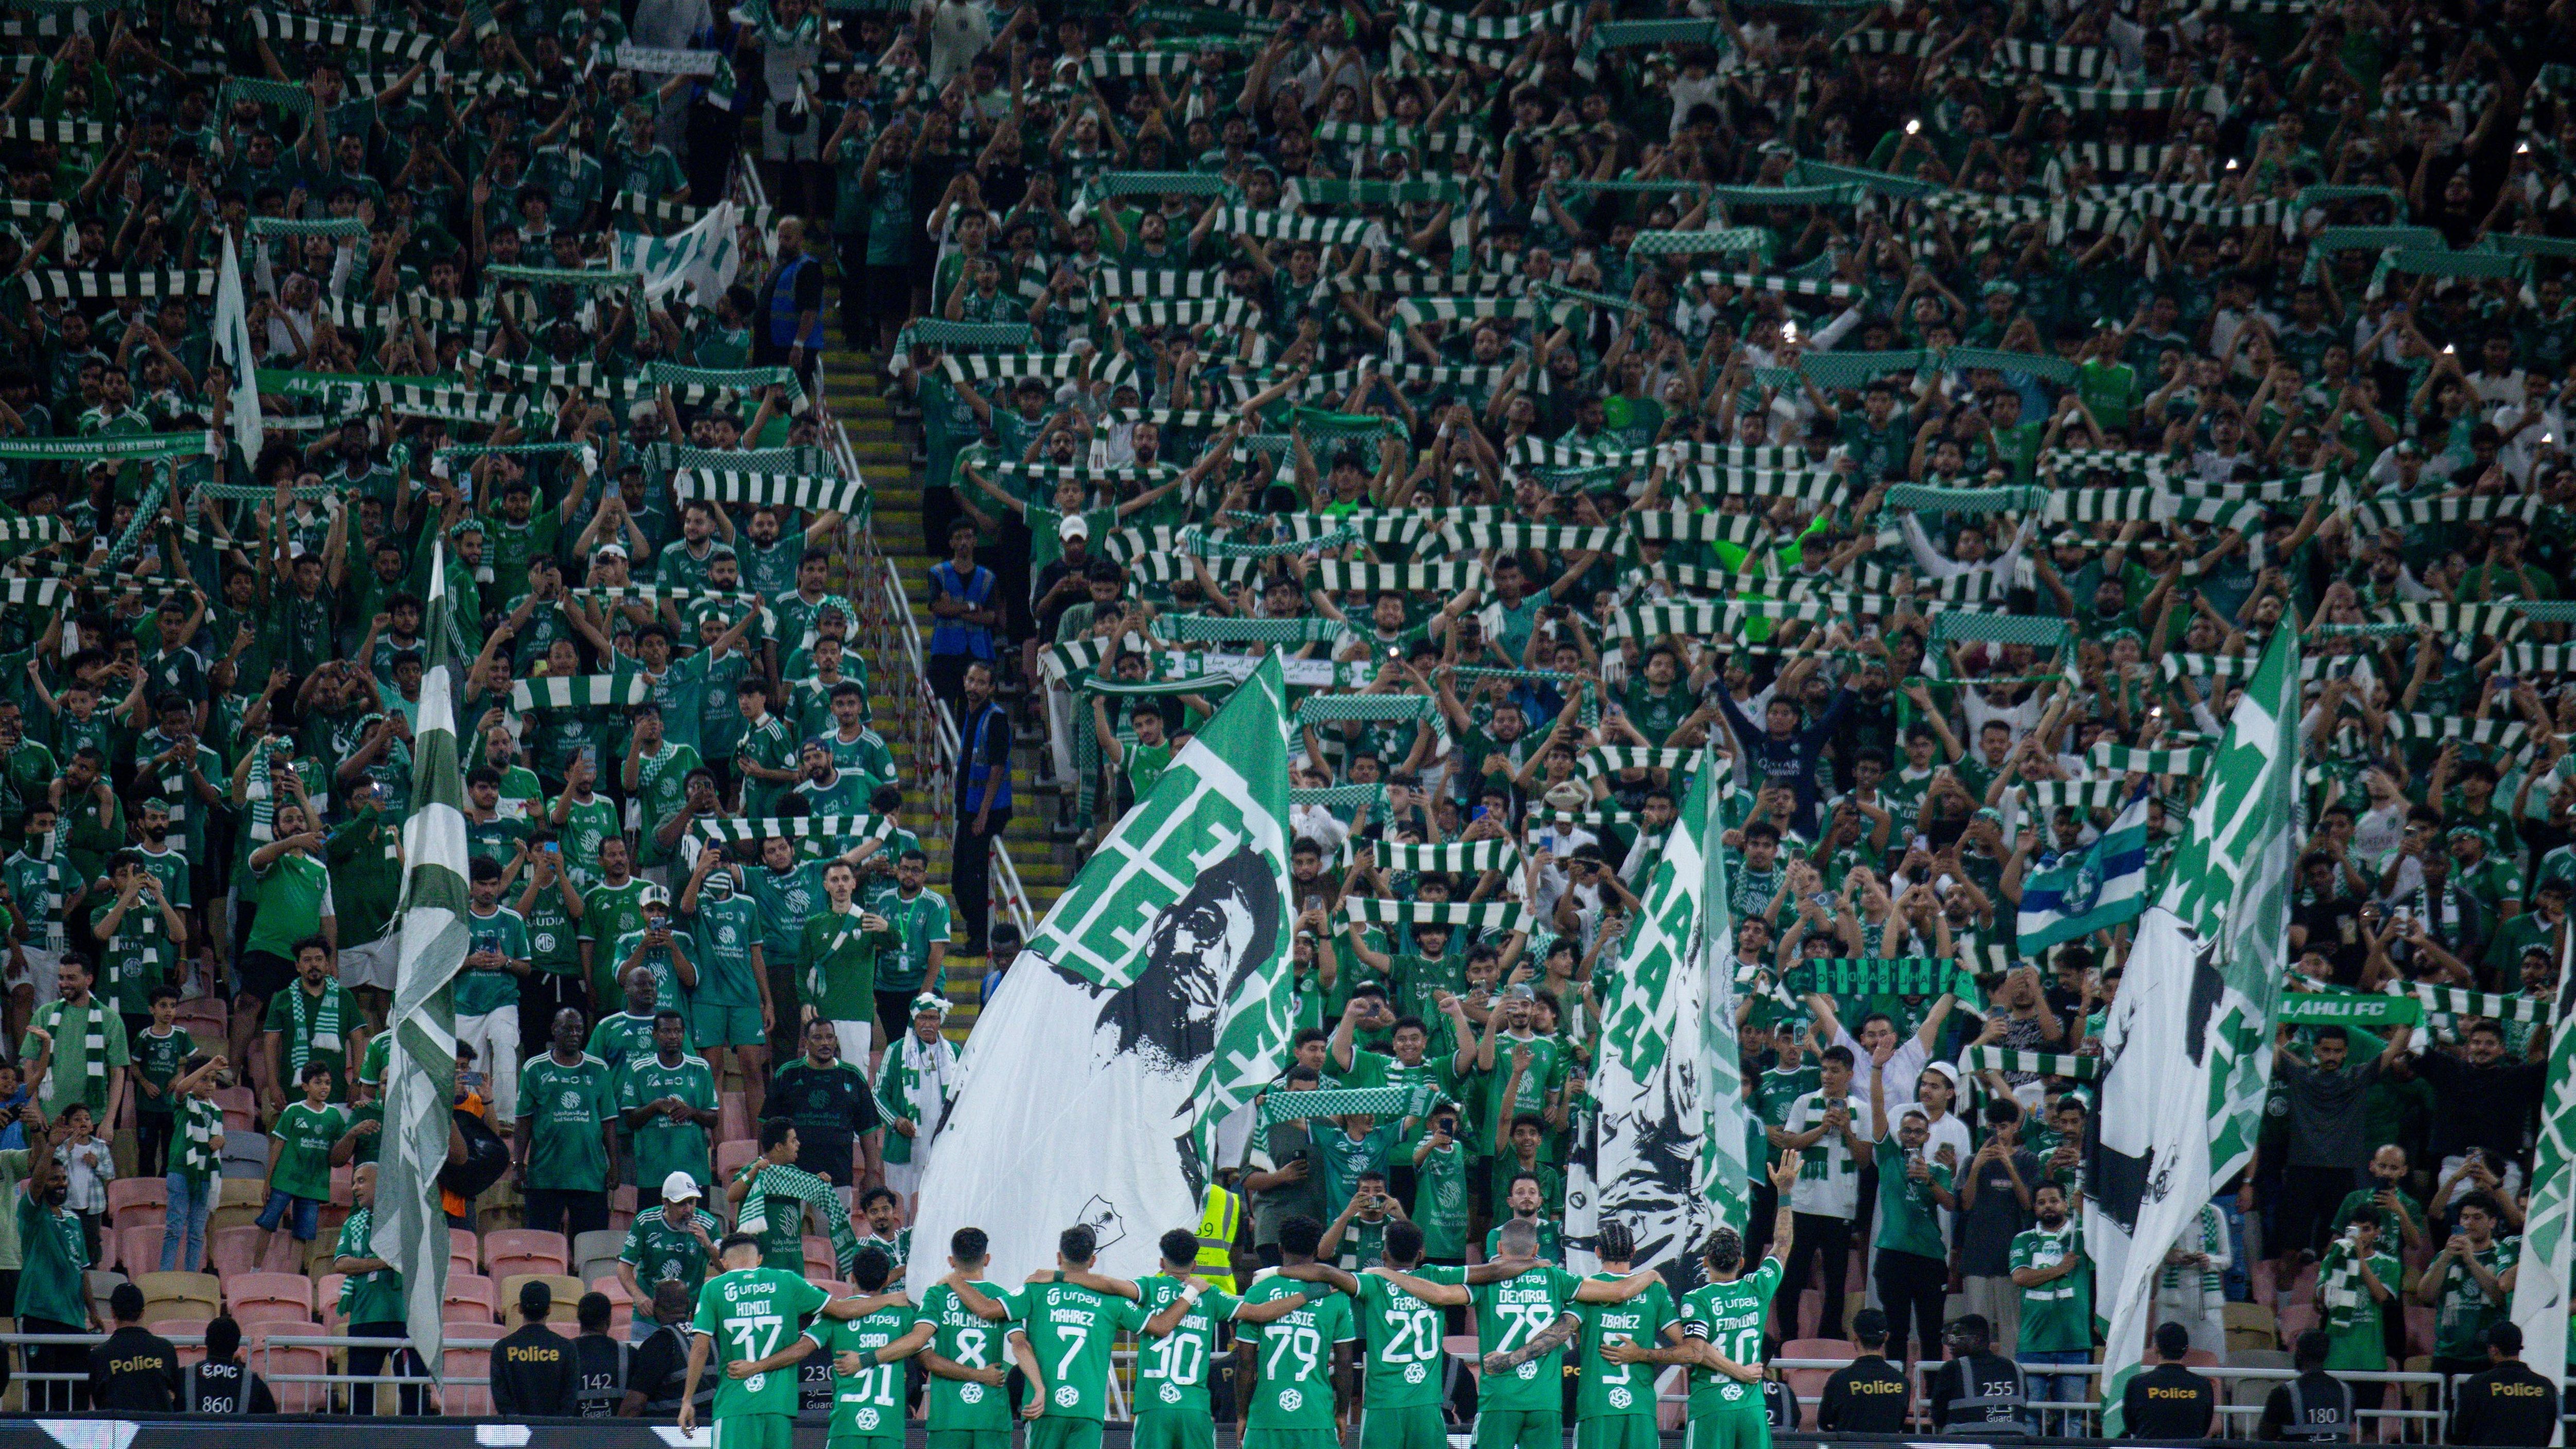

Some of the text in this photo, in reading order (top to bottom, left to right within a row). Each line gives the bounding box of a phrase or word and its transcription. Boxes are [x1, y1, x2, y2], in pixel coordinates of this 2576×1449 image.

[45, 443, 103, 453] ALWAYS
[1758, 758, 1799, 769] QATAR
[526, 916, 565, 928] SAUDIA
[2353, 1002, 2387, 1017] FC
[739, 1280, 776, 1295] urpay
[1063, 1291, 1102, 1307] urpay
[1499, 1289, 1551, 1303] DEMIRAL
[1725, 1295, 1759, 1310] urpay
[736, 1300, 771, 1317] HINDI
[863, 1313, 900, 1326] urpay
[1050, 1308, 1094, 1328] MAHREZ
[1716, 1312, 1759, 1332] FIRMINO
[1381, 1308, 1438, 1363] 20
[1684, 1324, 1694, 1335] C
[723, 1315, 783, 1363] 37
[859, 1334, 888, 1349] SAAD
[507, 1347, 560, 1362] Police
[955, 1328, 987, 1370] 8
[1056, 1326, 1088, 1381] 7
[1264, 1324, 1319, 1382] 79
[1143, 1333, 1203, 1386] 30
[1710, 1329, 1760, 1385] 10
[110, 1356, 163, 1375] Police
[200, 1362, 238, 1379] EPIC
[582, 1373, 612, 1390] 142
[1850, 1380, 1903, 1395] Police
[1983, 1381, 2013, 1396] 255
[2148, 1387, 2197, 1400] Police
[2490, 1382, 2545, 1397] Police
[203, 1396, 233, 1413] 860
[582, 1407, 612, 1419] Guard
[1986, 1413, 2012, 1423] Guard
[2307, 1408, 2338, 1424] 180
